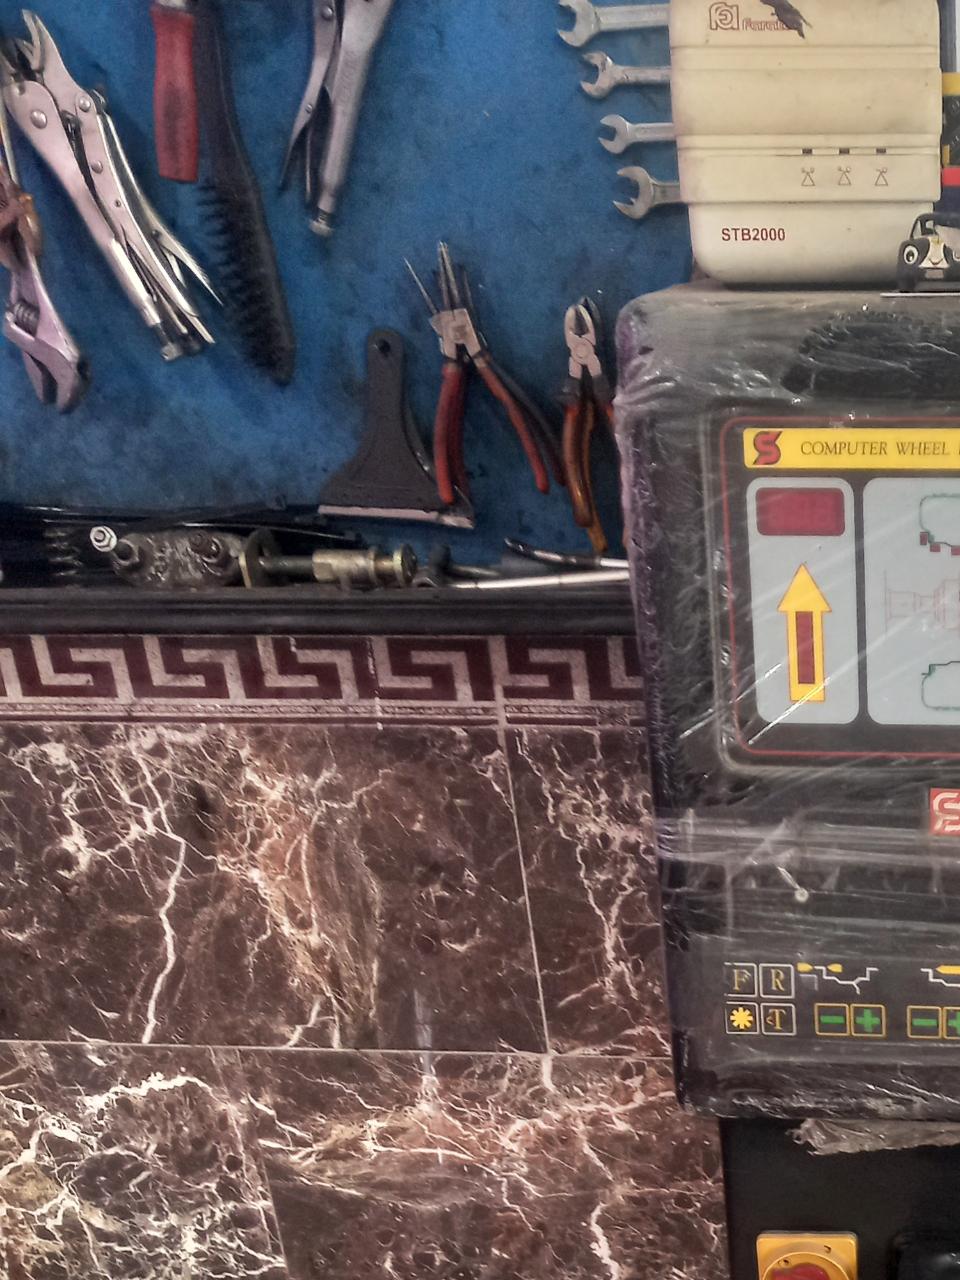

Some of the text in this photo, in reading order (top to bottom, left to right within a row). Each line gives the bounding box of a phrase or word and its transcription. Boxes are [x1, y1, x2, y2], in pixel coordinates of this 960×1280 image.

[721, 227, 786, 241] STB2000
[800, 440, 888, 456] COMPUTER
[896, 441, 950, 456] WHEEL
[770, 968, 785, 991] R
